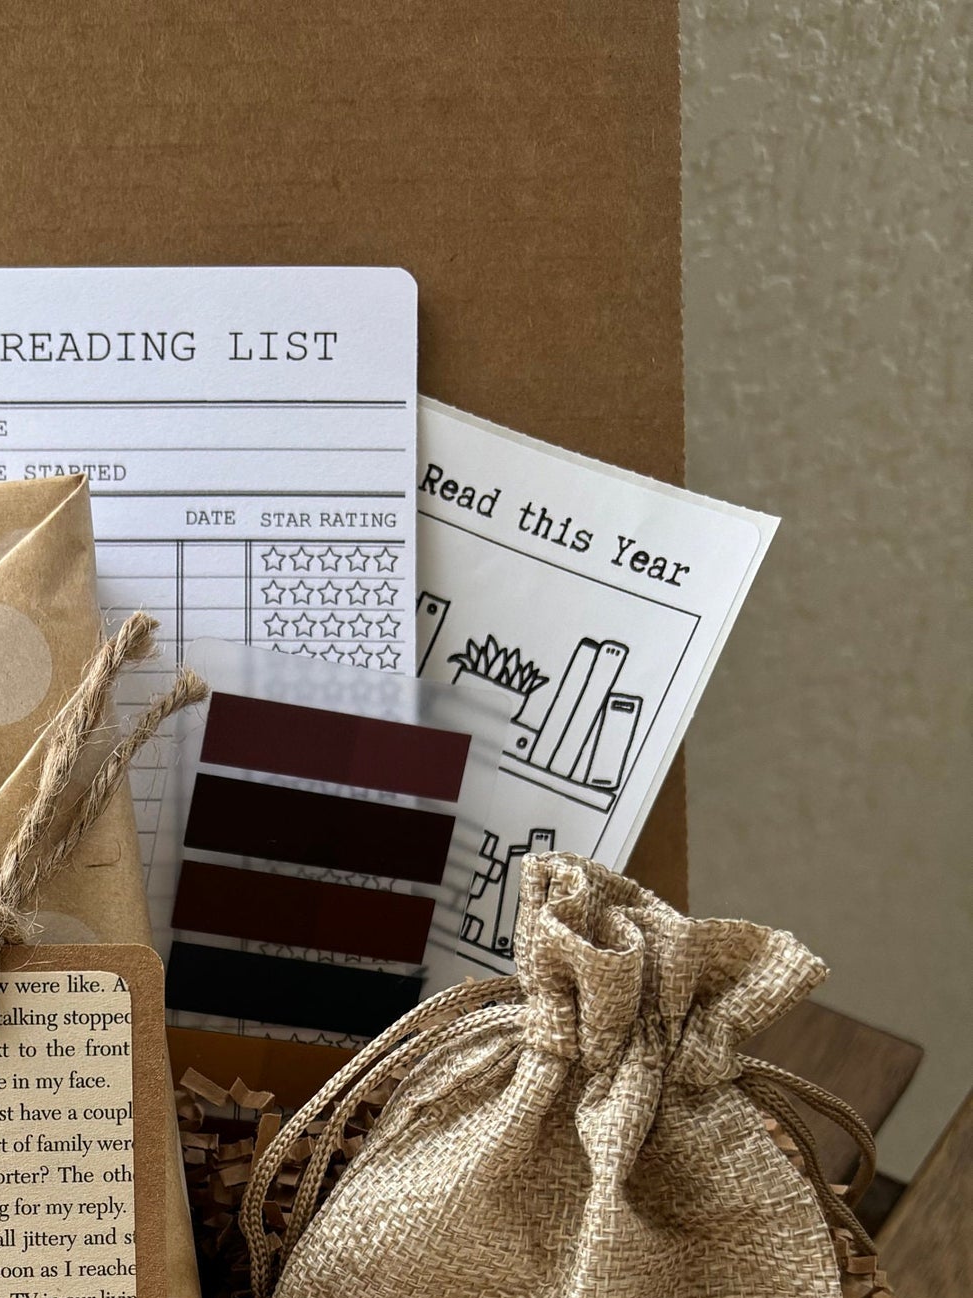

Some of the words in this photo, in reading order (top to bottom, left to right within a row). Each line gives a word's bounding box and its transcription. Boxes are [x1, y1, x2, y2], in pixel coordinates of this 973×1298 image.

[0, 331, 197, 362] READING
[228, 331, 338, 362] LIST
[24, 464, 127, 481] STARTED
[186, 511, 236, 526] DATE
[260, 512, 312, 528] STAR
[319, 512, 397, 528] RATING
[418, 463, 502, 518] Read
[518, 502, 594, 552] this
[611, 535, 690, 587] Year
[15, 982, 59, 994] were
[67, 976, 105, 994] like.
[19, 1044, 36, 1058] to
[47, 1040, 75, 1058] the
[85, 1039, 129, 1057] front
[12, 1074, 28, 1090] in
[36, 1077, 63, 1095] my
[69, 1071, 110, 1089] face.
[20, 1103, 61, 1121] have
[68, 1109, 77, 1121] a
[13, 1135, 31, 1153] of
[37, 1135, 91, 1158] family
[58, 1166, 94, 1184] The
[15, 1198, 40, 1215] for
[46, 1203, 72, 1220] my
[78, 1196, 126, 1219] reply.
[22, 1230, 76, 1252] jittery
[84, 1228, 116, 1246] and
[41, 1265, 58, 1277] as
